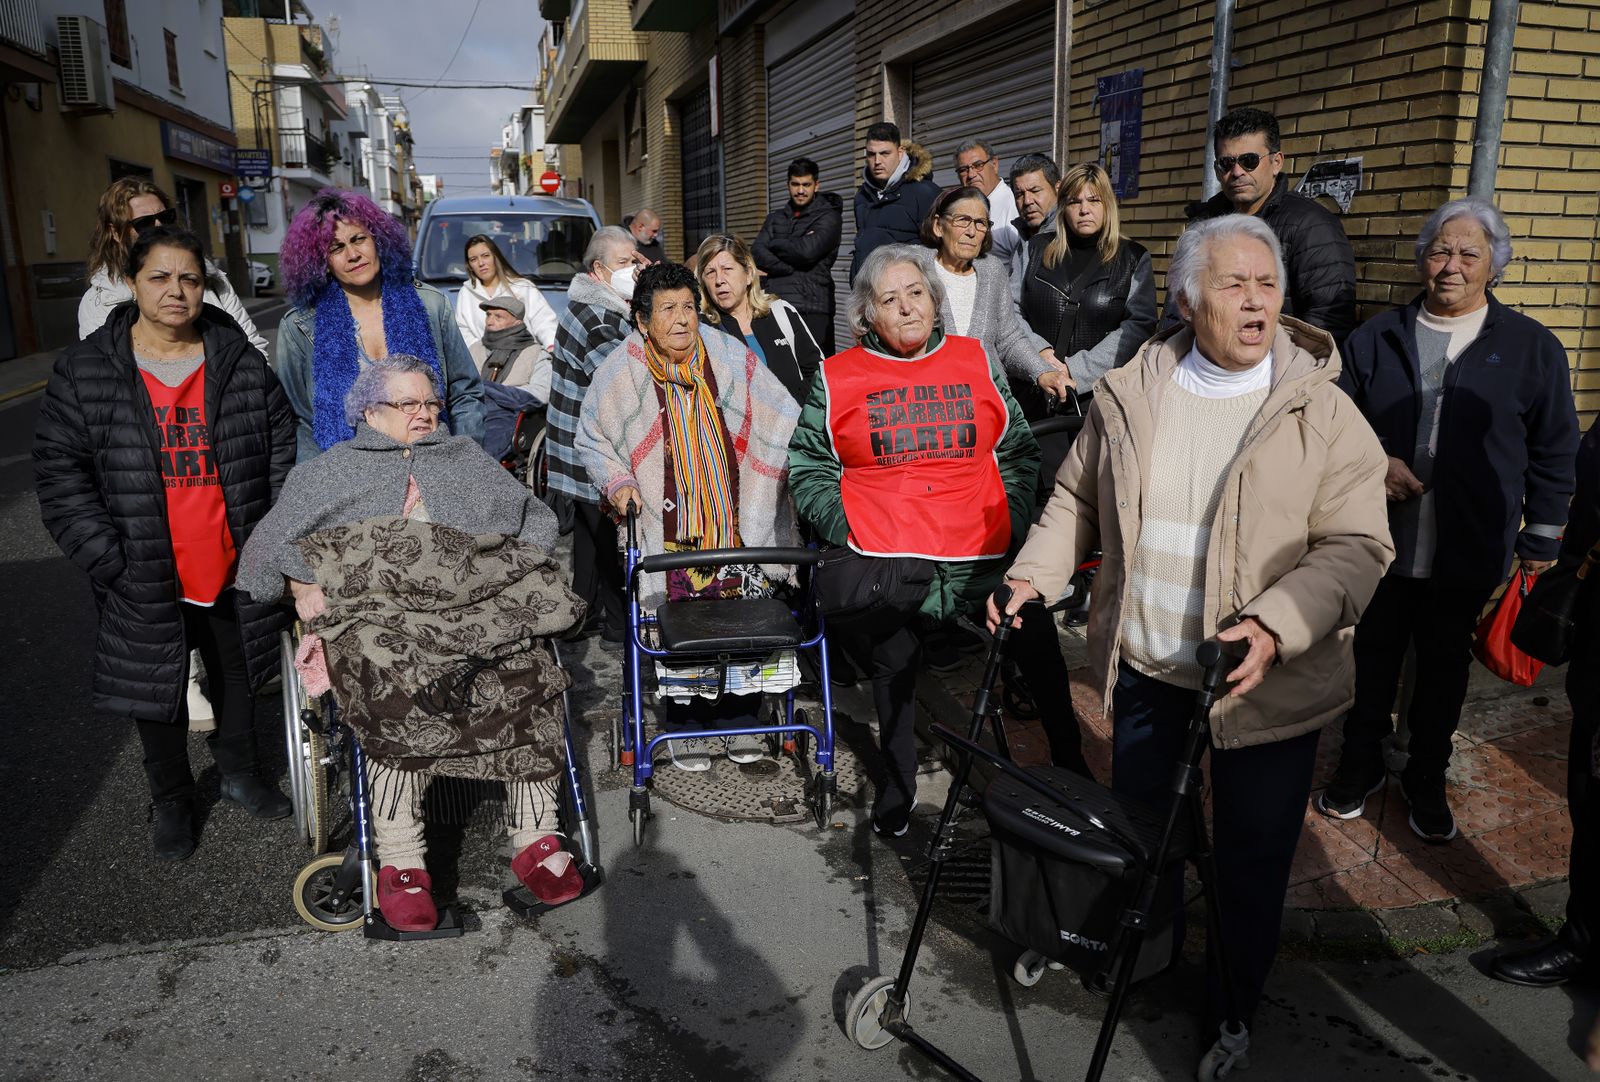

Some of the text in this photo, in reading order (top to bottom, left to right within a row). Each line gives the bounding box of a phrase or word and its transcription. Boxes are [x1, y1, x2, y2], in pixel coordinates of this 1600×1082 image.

[237, 151, 268, 159] MARTELL
[866, 383, 973, 406] SOY DE UN
[175, 407, 202, 424] DE
[868, 399, 975, 430] BARRIO
[869, 423, 977, 457] HARTO
[160, 450, 217, 477] ART
[927, 450, 964, 460] DIGNIDAD
[179, 478, 186, 487] Y
[1049, 821, 1081, 836] BAMI
